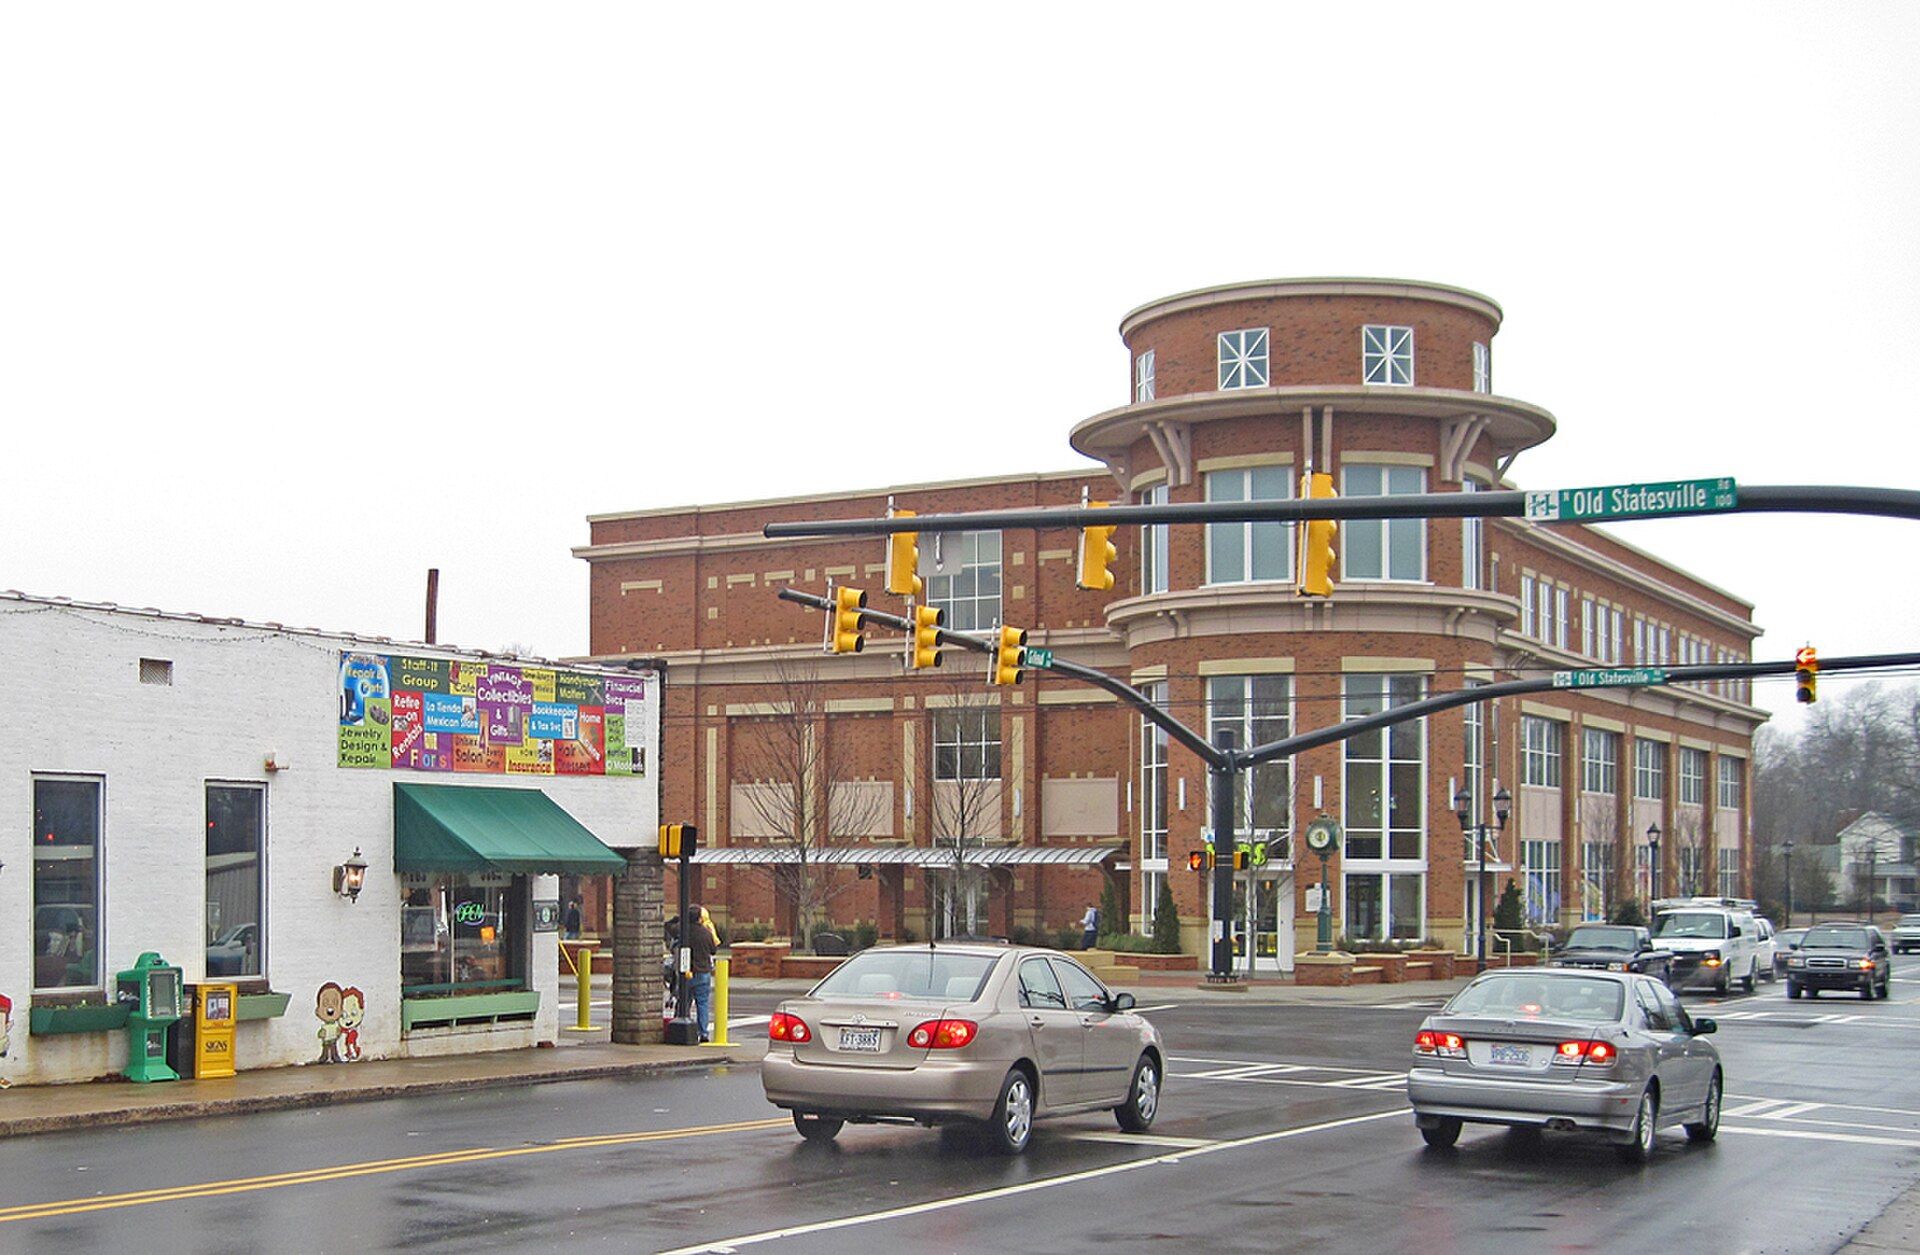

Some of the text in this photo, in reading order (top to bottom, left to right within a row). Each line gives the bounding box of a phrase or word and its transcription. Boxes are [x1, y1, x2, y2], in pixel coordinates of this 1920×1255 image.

[1573, 489, 1604, 516] Old
[1611, 484, 1706, 514] Statesville
[1714, 493, 1733, 507] 100
[402, 674, 439, 691] Group
[487, 671, 523, 691] VINTAGE
[1578, 673, 1596, 686] Old
[1598, 671, 1649, 686] Statesville
[605, 680, 643, 694] Financial
[477, 686, 533, 705] Collectibles
[437, 701, 462, 714] Tienda
[531, 703, 578, 719] Bookkeeping
[405, 711, 419, 722] on
[426, 715, 460, 728] Mexican
[579, 711, 602, 724] Home
[341, 726, 383, 740] Jewelry
[489, 723, 509, 738] Gifts
[340, 739, 389, 753] Design &
[391, 722, 423, 760] Rentals
[340, 752, 378, 765] Repair
[455, 747, 484, 764] Salon
[507, 760, 552, 774] Insurance
[456, 903, 485, 923] OPEN
